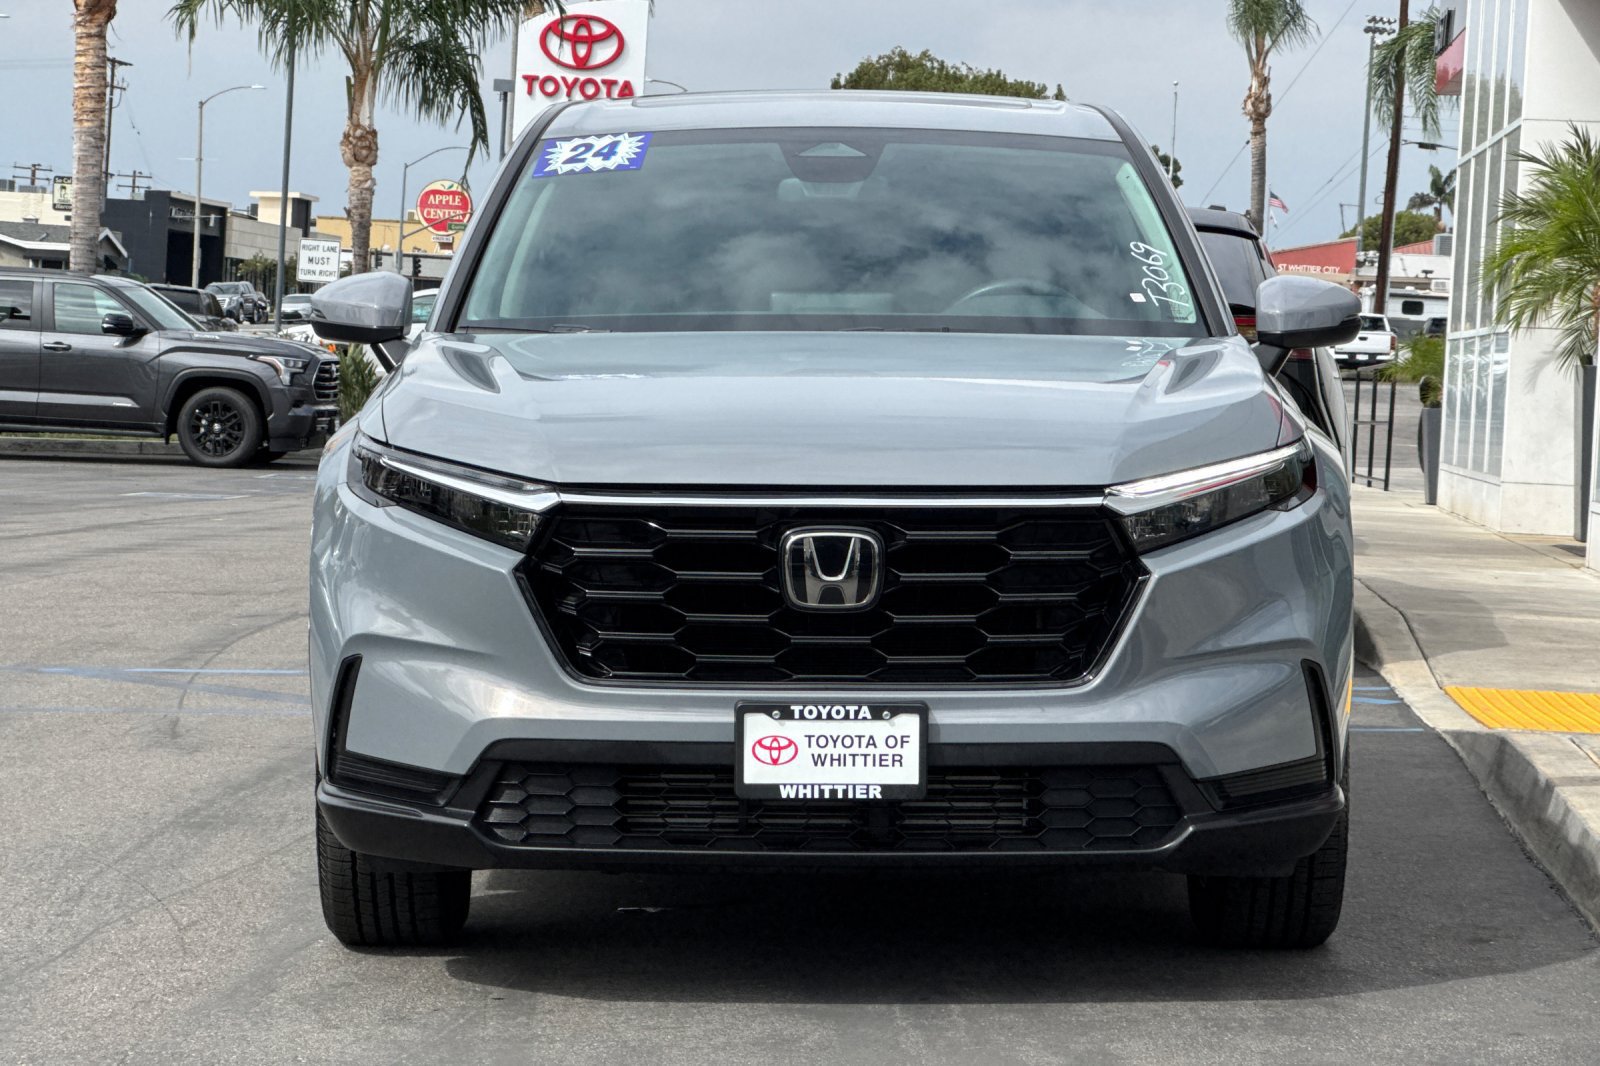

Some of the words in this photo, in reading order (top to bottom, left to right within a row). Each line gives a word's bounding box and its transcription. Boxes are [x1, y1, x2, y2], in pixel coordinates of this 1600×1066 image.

[522, 75, 635, 99] TOYOTA
[561, 140, 623, 165] 24
[427, 194, 462, 206] APPLE
[423, 207, 464, 220] CENTER
[301, 244, 320, 252] RIGHT
[322, 245, 338, 253] LANE
[307, 256, 331, 266] MUST
[300, 268, 317, 277] TURN
[318, 269, 337, 278] RIGHT
[1129, 241, 1190, 307] T3069
[1288, 264, 1321, 274] WHITTIER
[1322, 265, 1341, 275] CITY
[790, 705, 872, 720] TOYOTA
[804, 734, 877, 749] TOYOTA
[885, 734, 911, 749] OF
[812, 753, 904, 768] WHITTIER
[779, 784, 882, 799] WHITTIER
